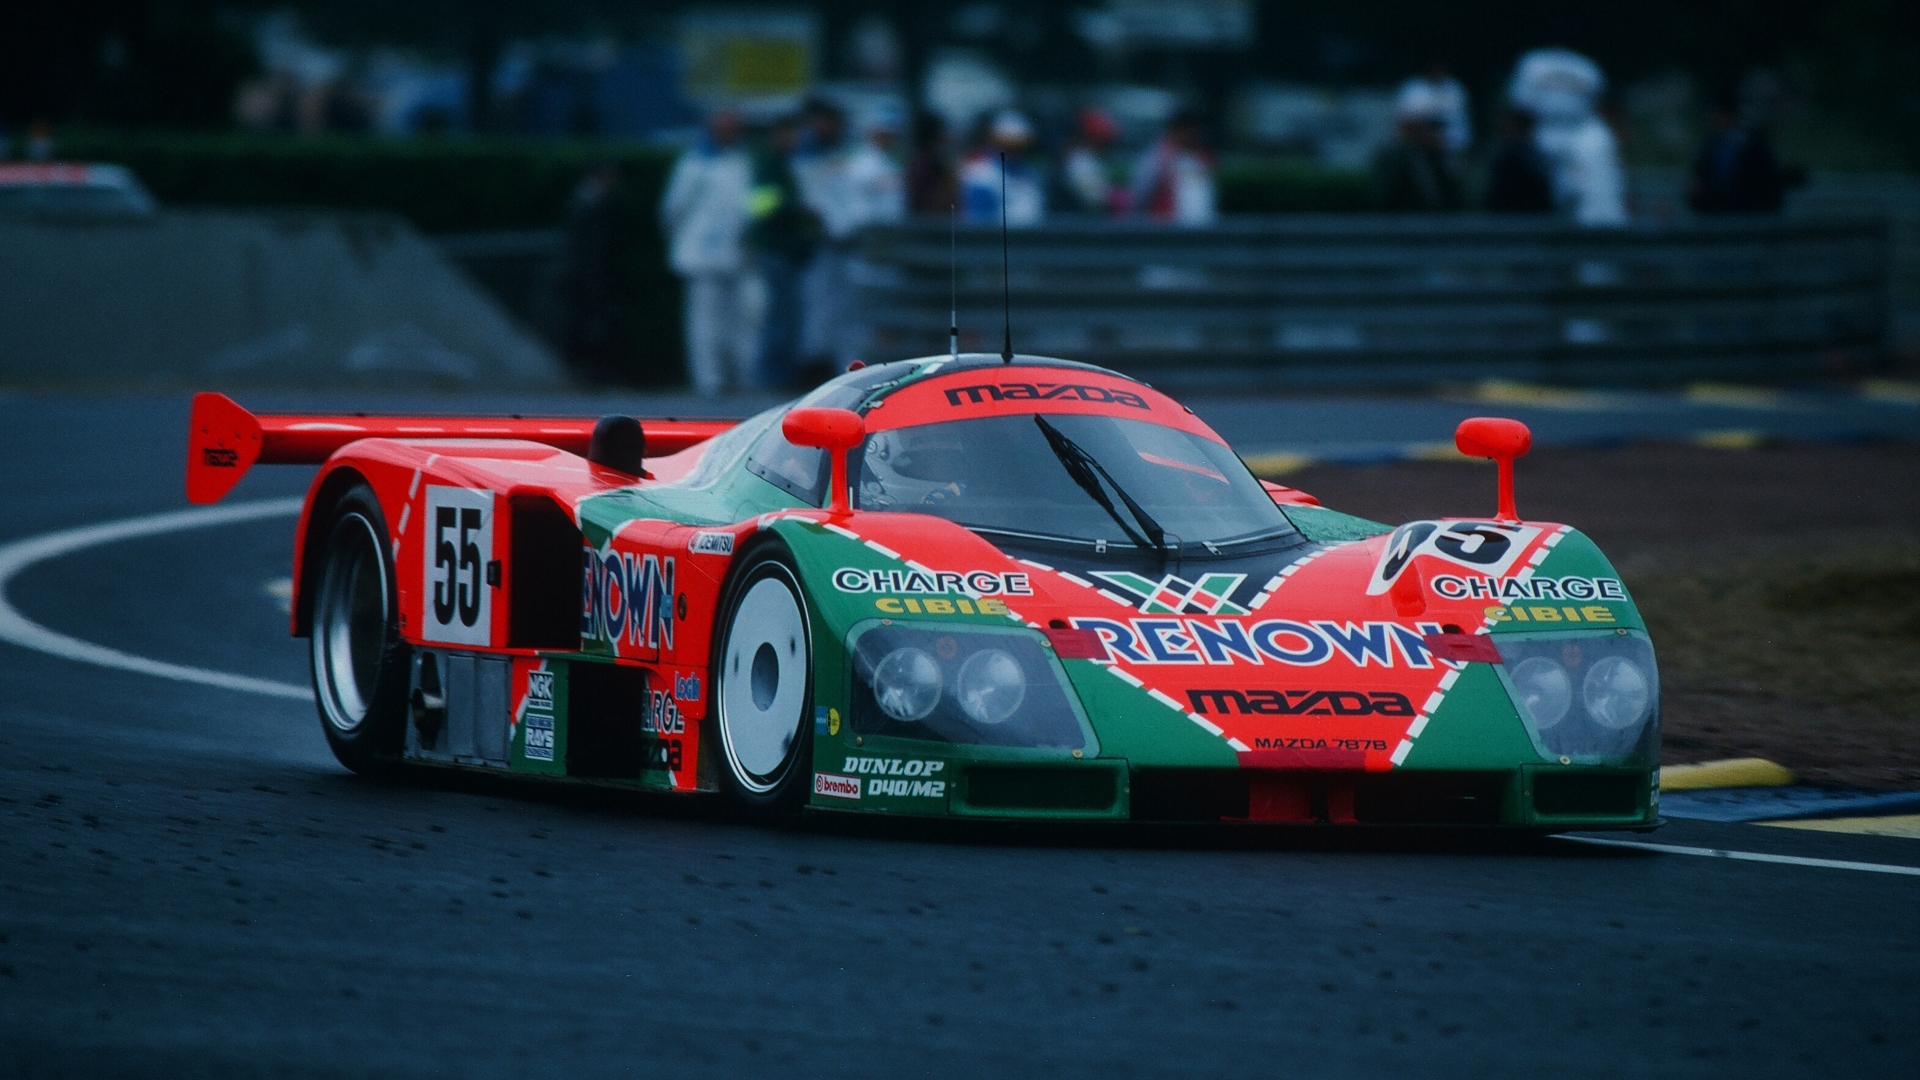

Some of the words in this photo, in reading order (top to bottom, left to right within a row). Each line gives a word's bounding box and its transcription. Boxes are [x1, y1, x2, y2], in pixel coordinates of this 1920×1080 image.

[433, 506, 482, 628] 55
[832, 567, 1034, 597] CHARGE
[1430, 574, 1628, 602] CHARGE
[1068, 617, 1469, 669] RENOWN
[528, 674, 553, 699] NGK
[525, 727, 554, 749] RAYS
[1255, 738, 1328, 749] MAZDA
[1332, 739, 1388, 751] 787B
[842, 757, 945, 776] DUNLOP
[824, 777, 859, 794] brembo
[868, 779, 946, 797] D40/M2
